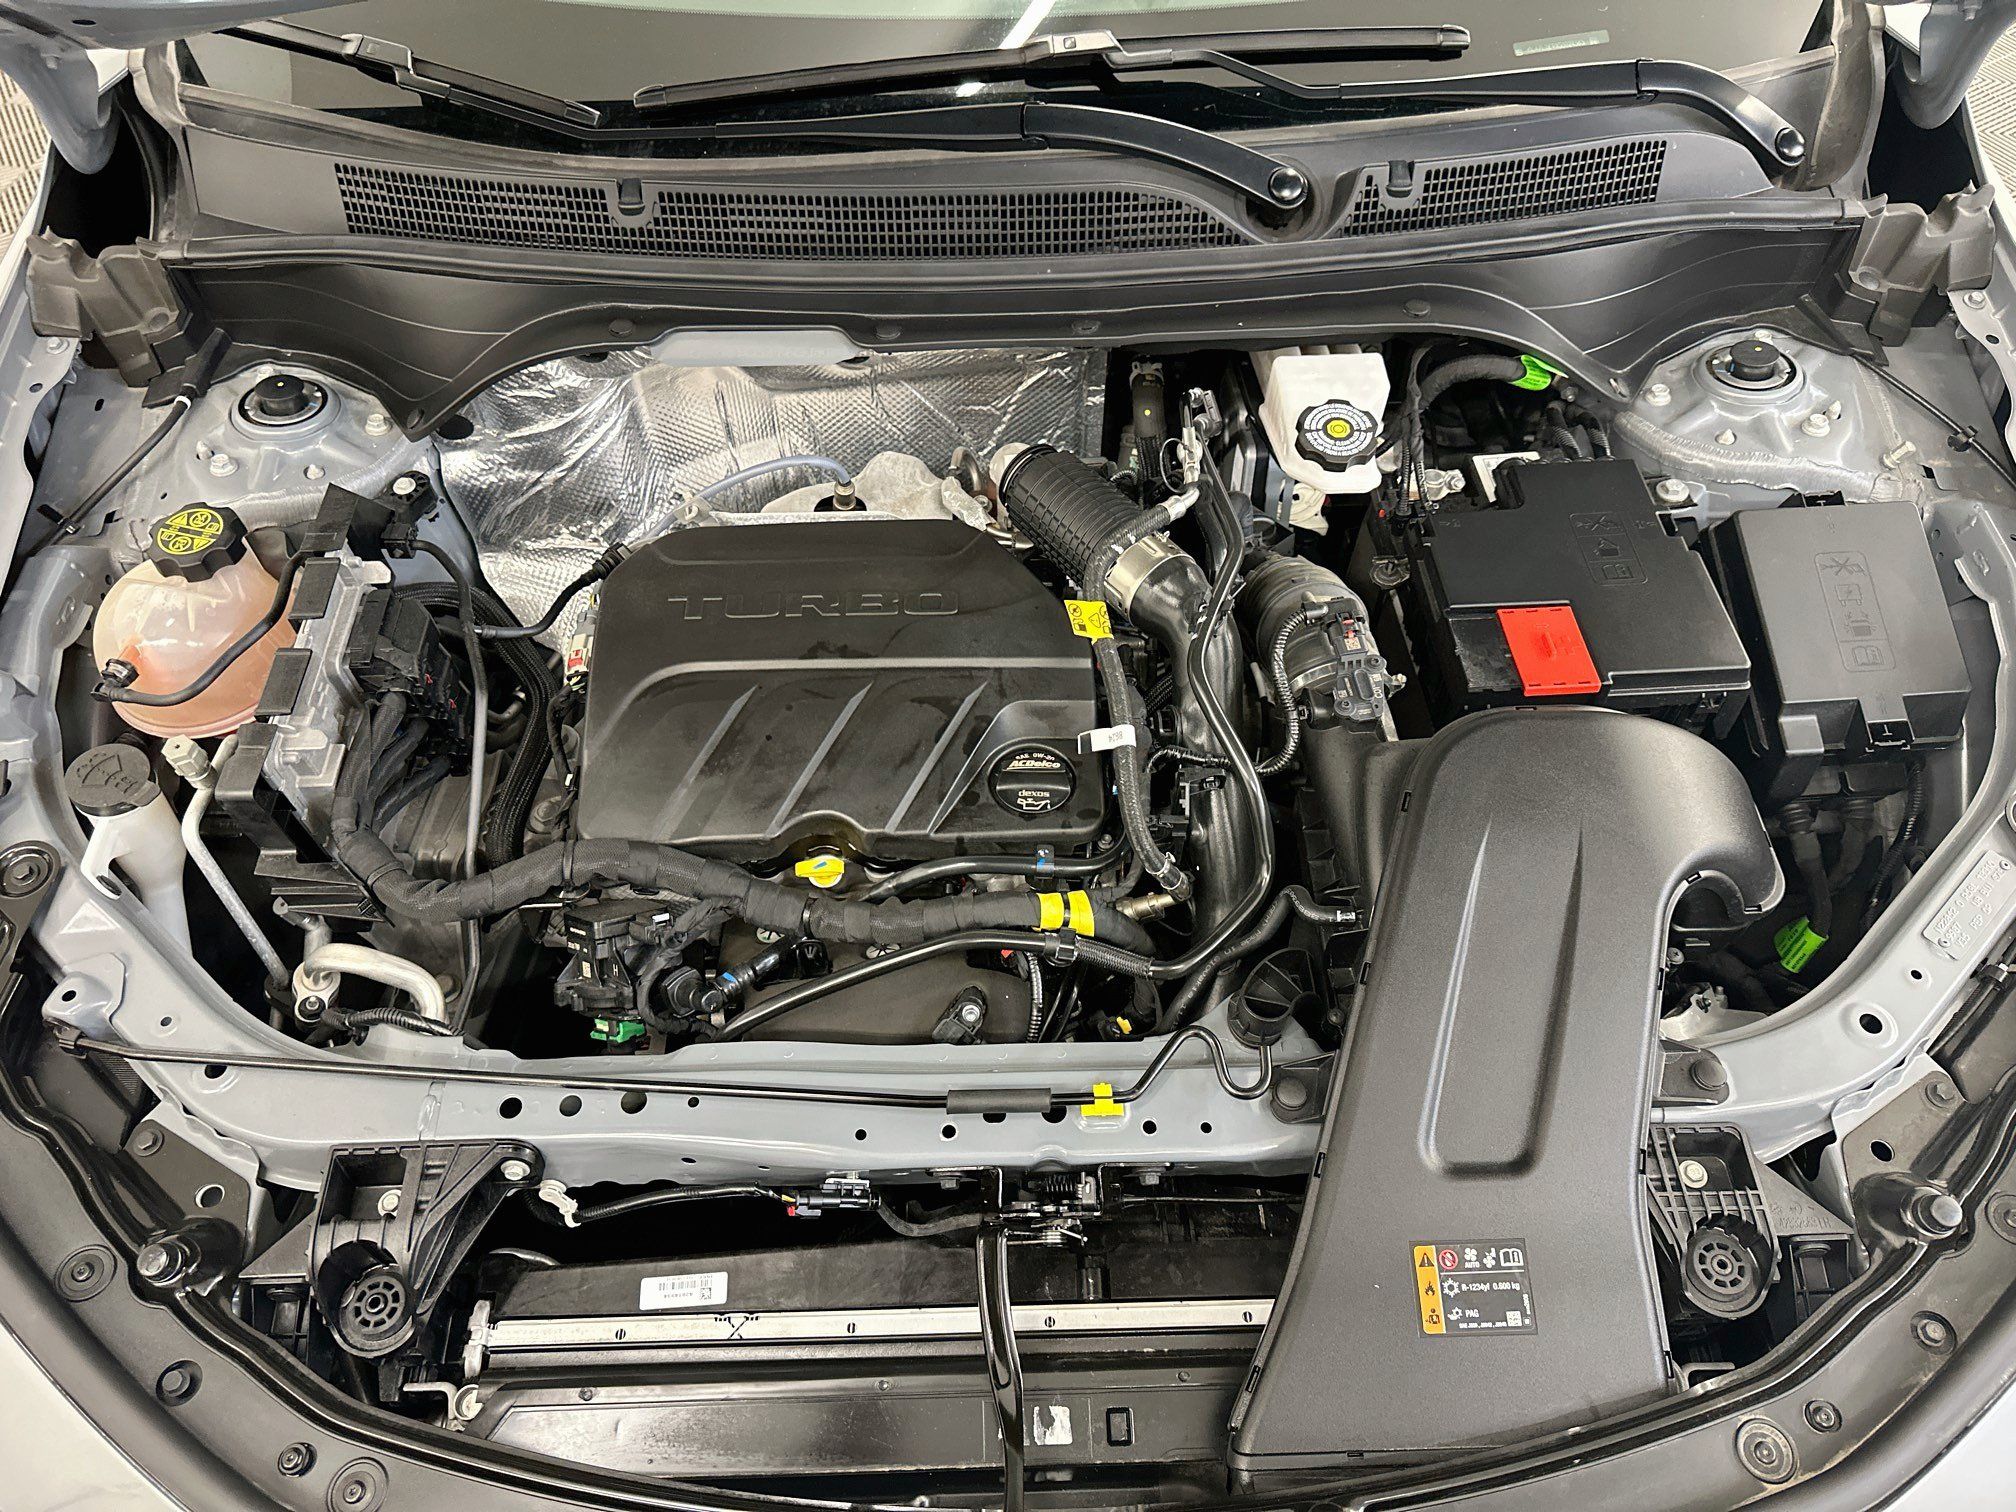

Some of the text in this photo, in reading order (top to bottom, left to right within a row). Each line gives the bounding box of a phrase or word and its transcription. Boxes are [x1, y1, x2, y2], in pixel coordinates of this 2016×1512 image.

[667, 592, 959, 620] TURBO
[1007, 760, 1061, 769] ACDelco
[1465, 1261, 1480, 1269] AUTO
[1512, 1281, 1520, 1291] kg
[1465, 1309, 1480, 1318] PAG
